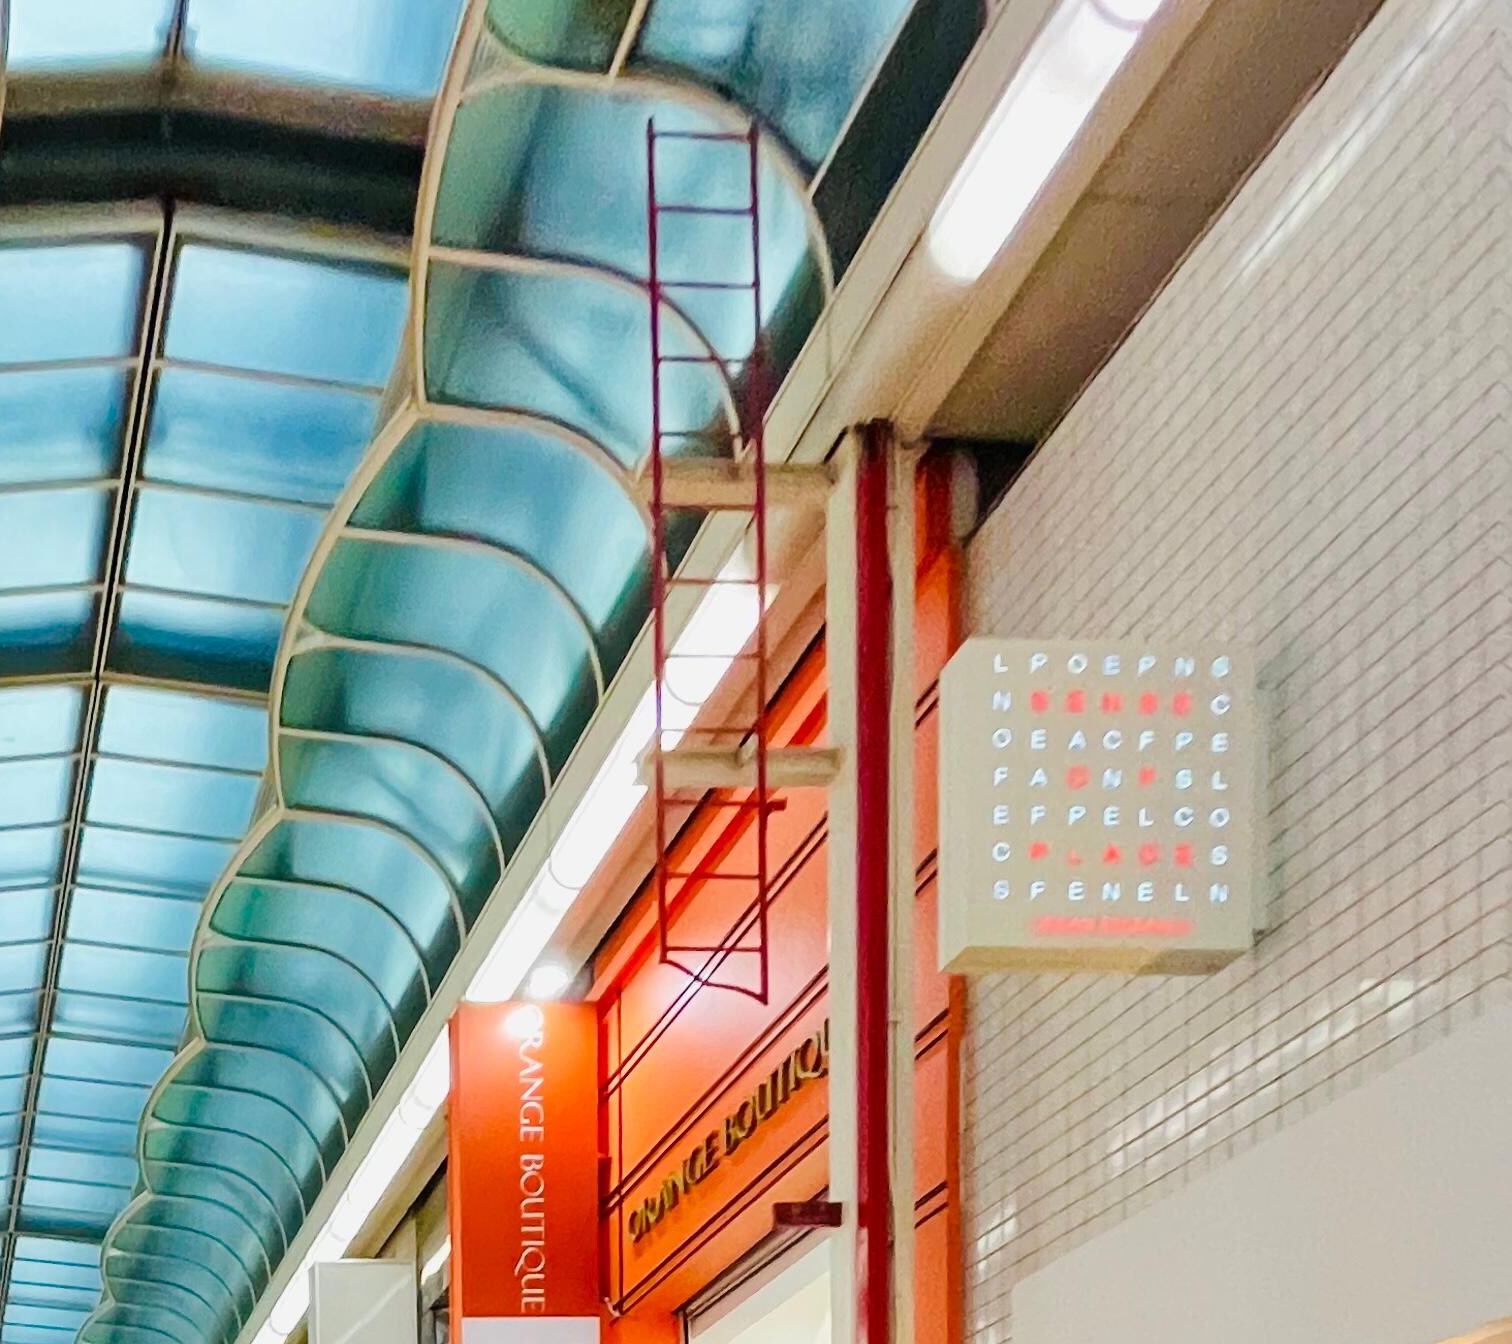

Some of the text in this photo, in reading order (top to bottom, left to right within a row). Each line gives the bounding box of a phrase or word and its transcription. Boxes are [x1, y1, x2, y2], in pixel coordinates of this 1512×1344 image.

[514, 1004, 545, 1313] ORANGE BOUTIQUE
[628, 1130, 720, 1244] ORANGE
